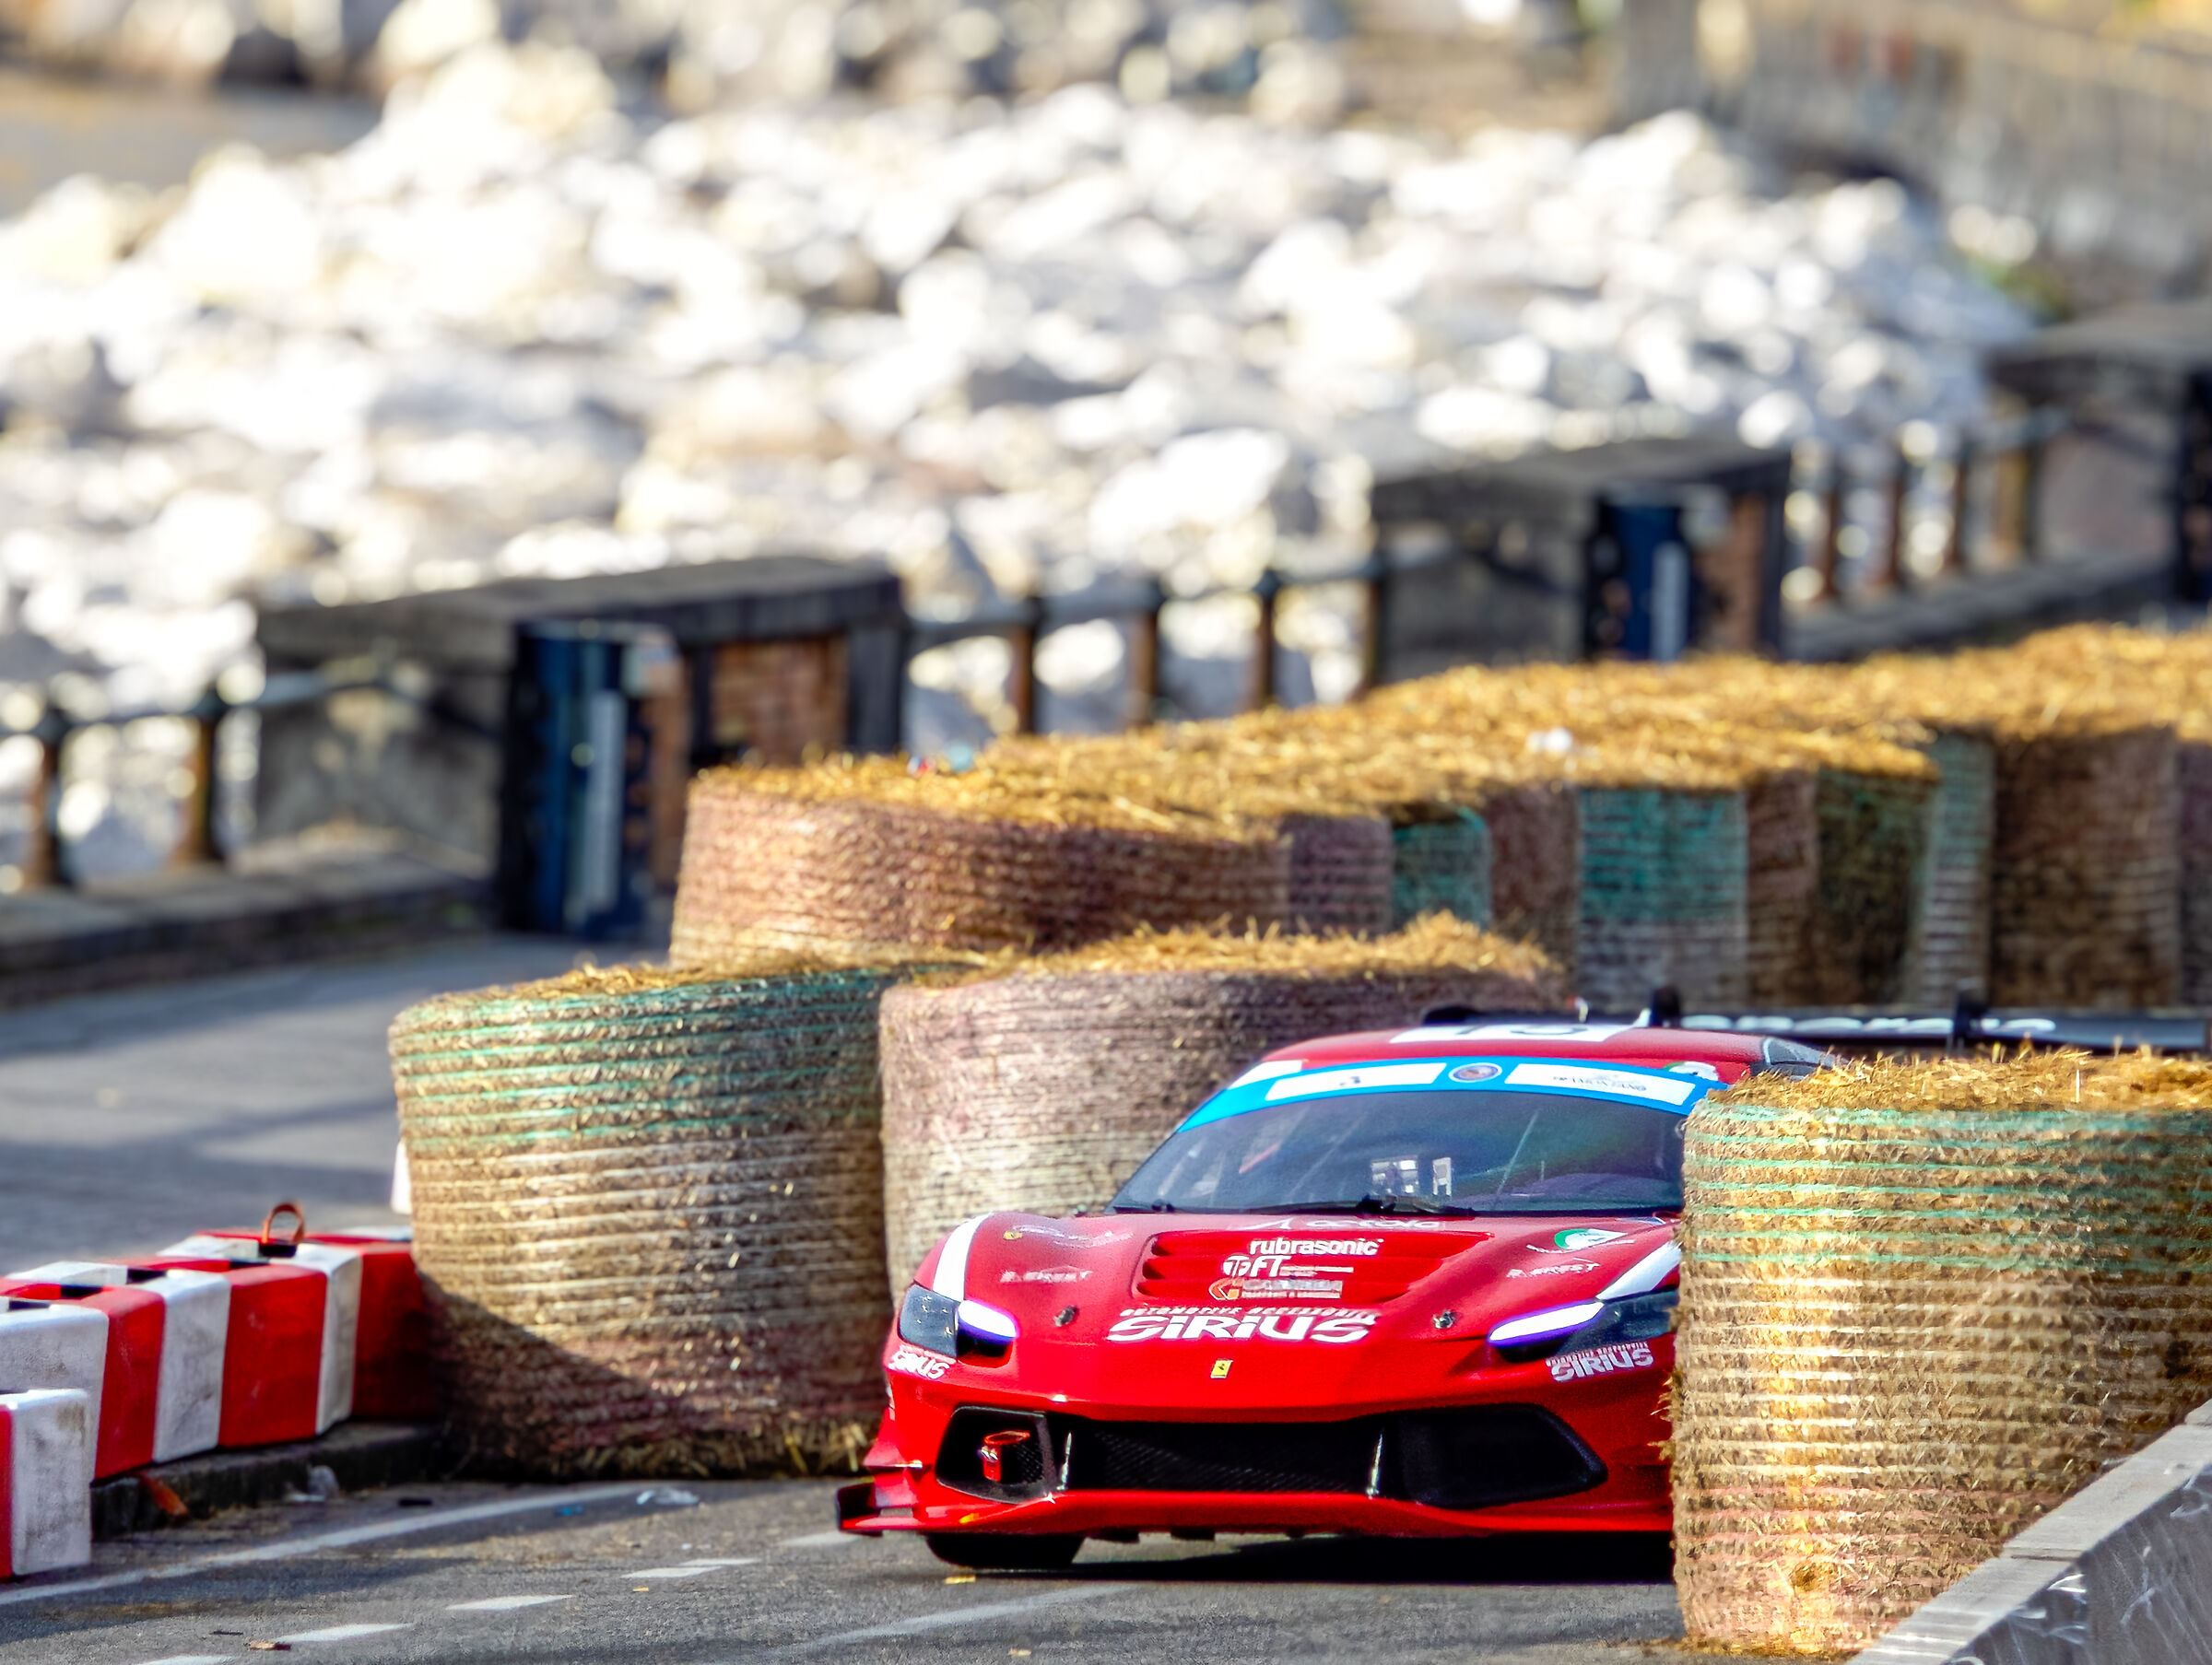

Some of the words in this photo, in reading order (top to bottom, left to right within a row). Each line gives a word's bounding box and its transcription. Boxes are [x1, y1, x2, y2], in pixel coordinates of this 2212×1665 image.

[1249, 1237, 1383, 1256] rubrasonic
[1106, 1315, 1377, 1343] SiRiUS
[1551, 1348, 1653, 1382] SIRIUS
